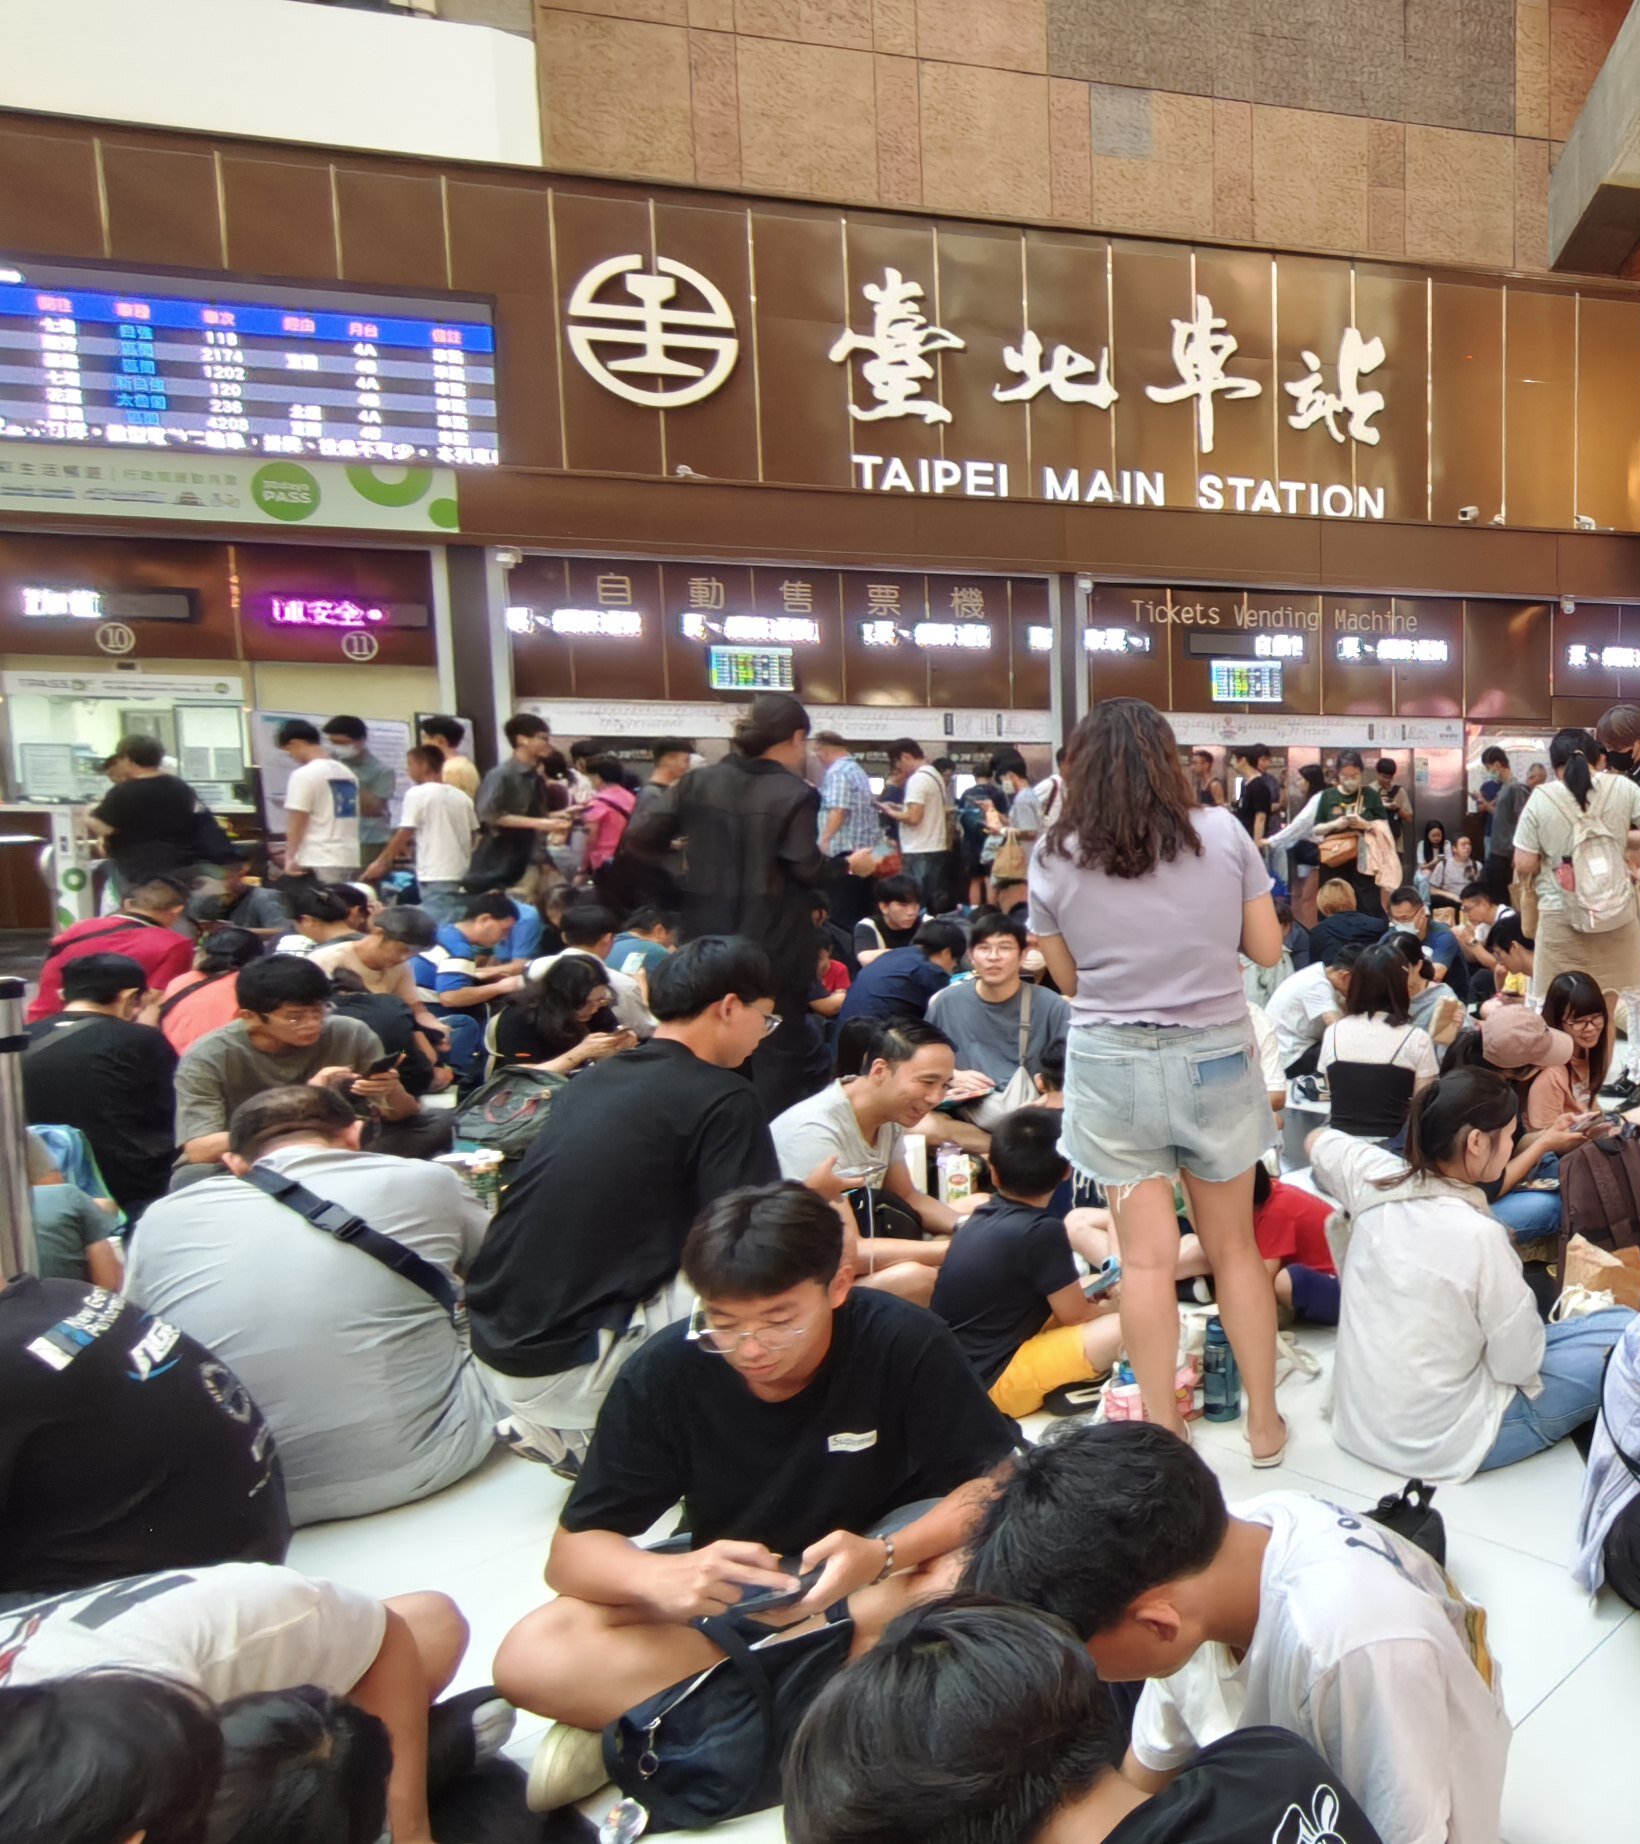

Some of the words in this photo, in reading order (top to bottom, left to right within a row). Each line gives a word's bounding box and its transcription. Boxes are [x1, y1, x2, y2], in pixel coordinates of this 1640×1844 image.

[349, 322, 378, 338] 月台
[201, 348, 243, 363] 2174
[828, 267, 1386, 453] 臺北車站
[204, 366, 246, 381] 1202
[210, 383, 242, 397] 120
[851, 453, 1008, 498] TAIPEI
[1045, 465, 1165, 507] MAIN
[1197, 474, 1386, 520] STATION
[263, 489, 312, 504] PASS
[596, 573, 986, 619] 自動售票機
[1132, 600, 1220, 625] Tickets
[1234, 604, 1320, 632] Vending
[1334, 608, 1418, 632] Machine
[105, 629, 128, 648] 10
